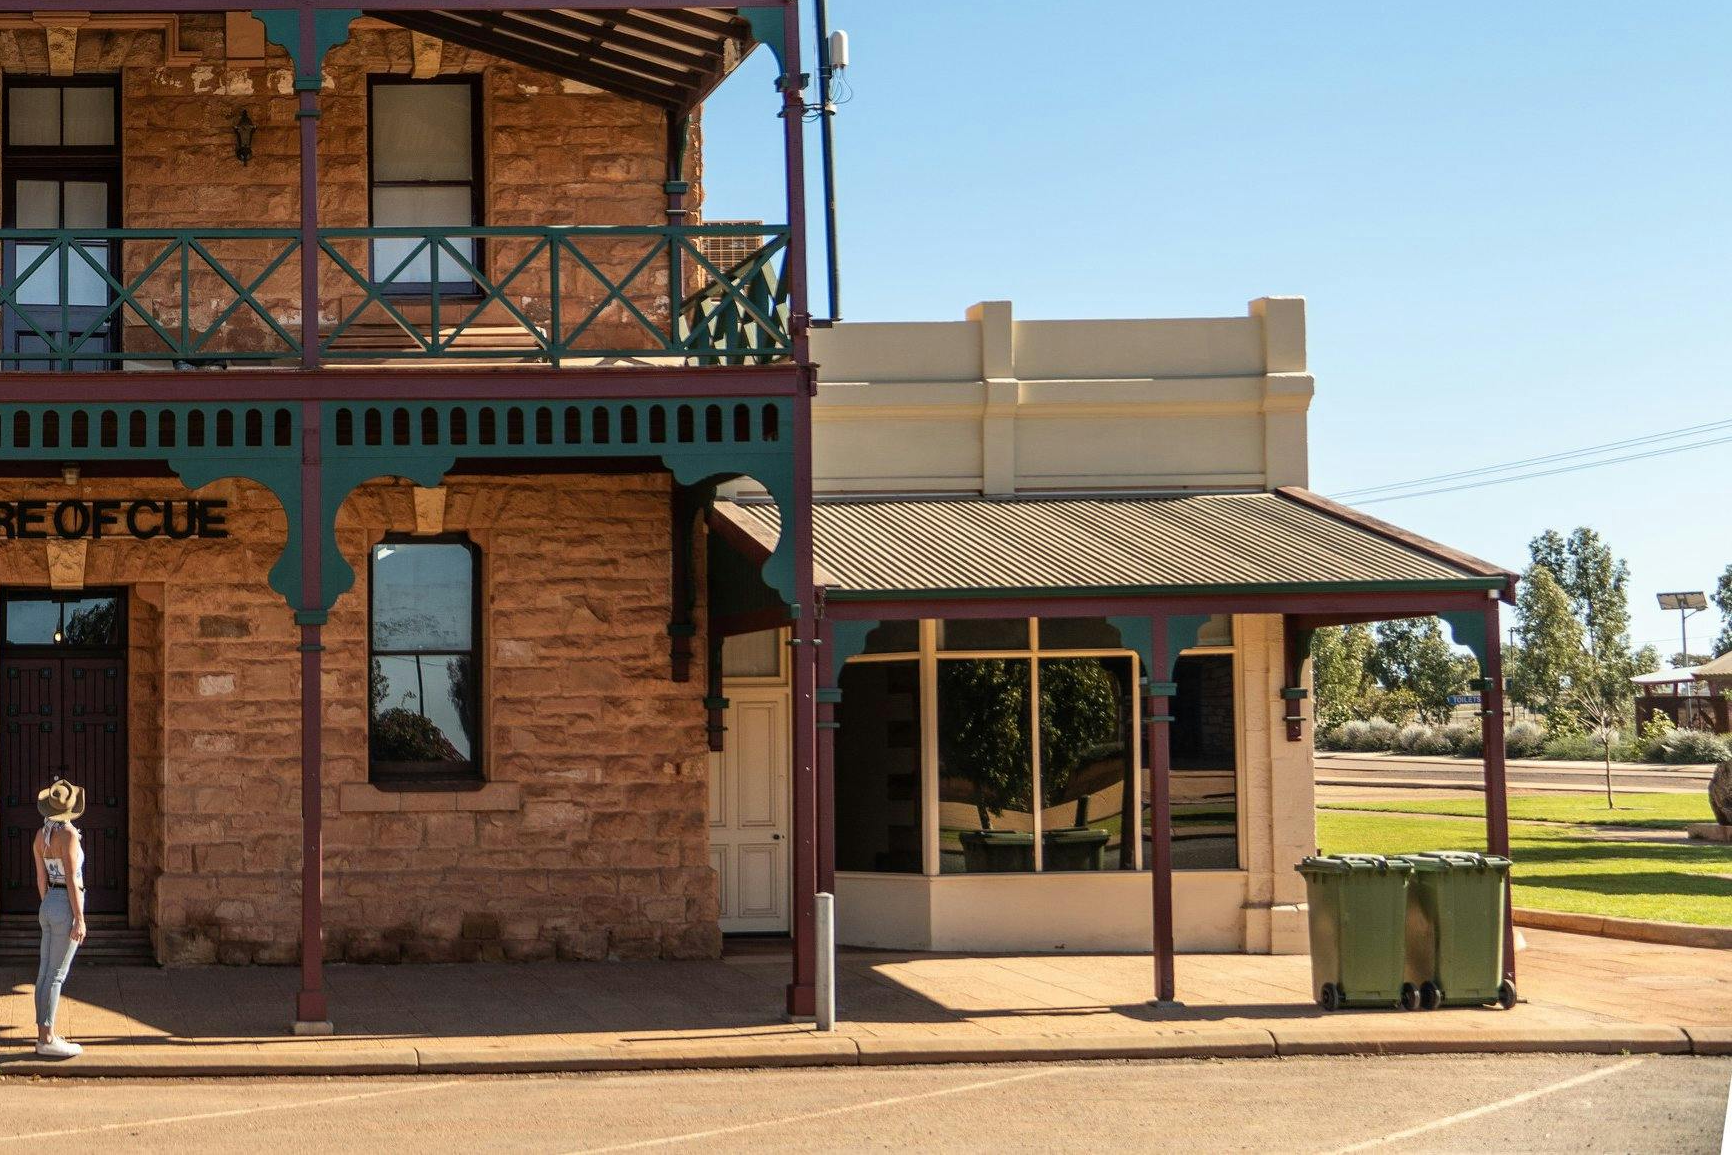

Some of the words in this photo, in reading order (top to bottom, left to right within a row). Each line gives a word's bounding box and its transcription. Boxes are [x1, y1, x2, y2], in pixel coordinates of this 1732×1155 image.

[54, 498, 121, 539] OF
[127, 498, 228, 539] CUE
[1453, 696, 1481, 704] TOILETS
